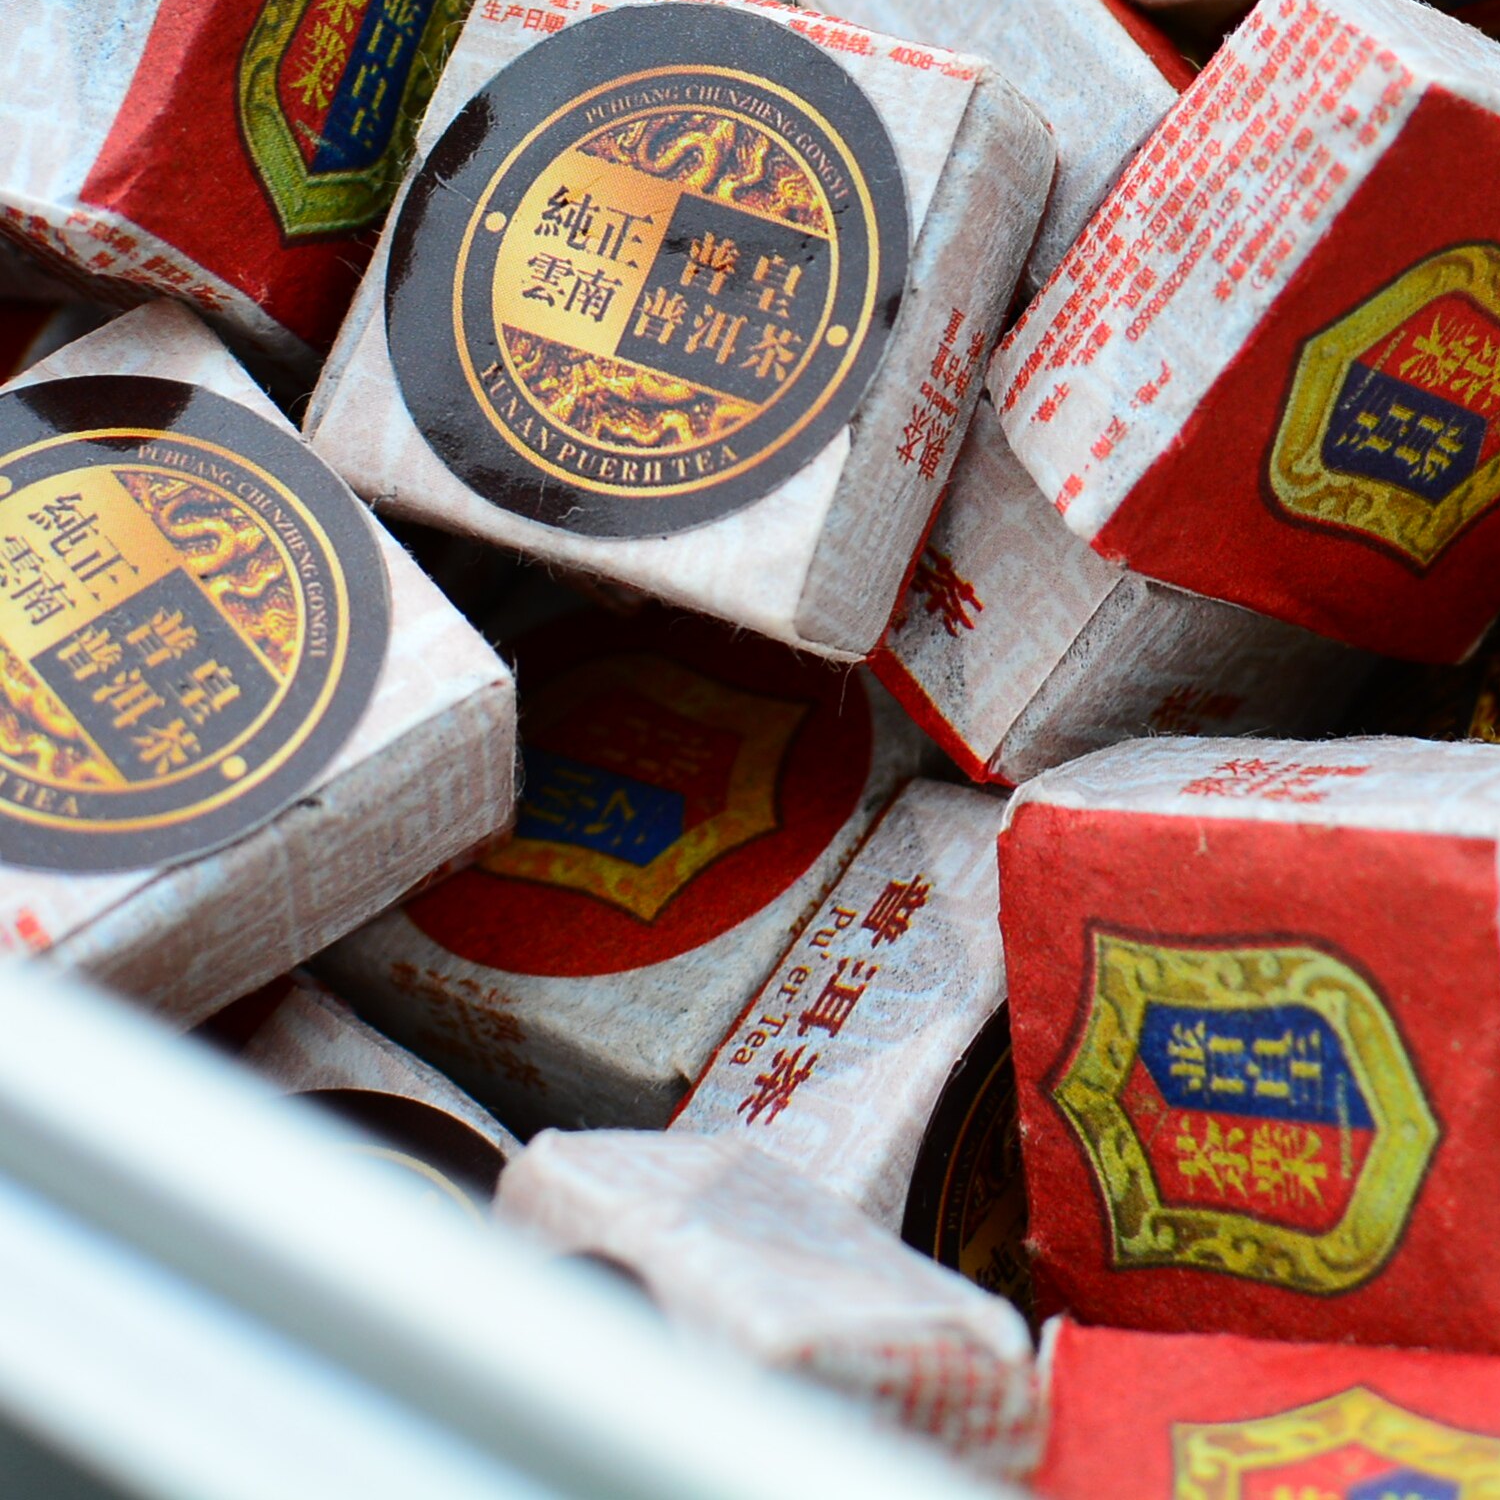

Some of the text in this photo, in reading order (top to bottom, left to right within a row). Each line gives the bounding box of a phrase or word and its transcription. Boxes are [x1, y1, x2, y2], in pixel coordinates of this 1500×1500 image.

[684, 83, 798, 138] CHUNZHENG
[534, 185, 654, 270] 純正
[521, 251, 623, 324] 雲南
[632, 286, 802, 384] 普洱茶
[557, 441, 662, 483] PUERH
[671, 443, 739, 479] TEA
[56, 626, 201, 777] 普洱茶
[736, 873, 934, 1126] 普洱茶
[729, 1012, 792, 1067] Tea
